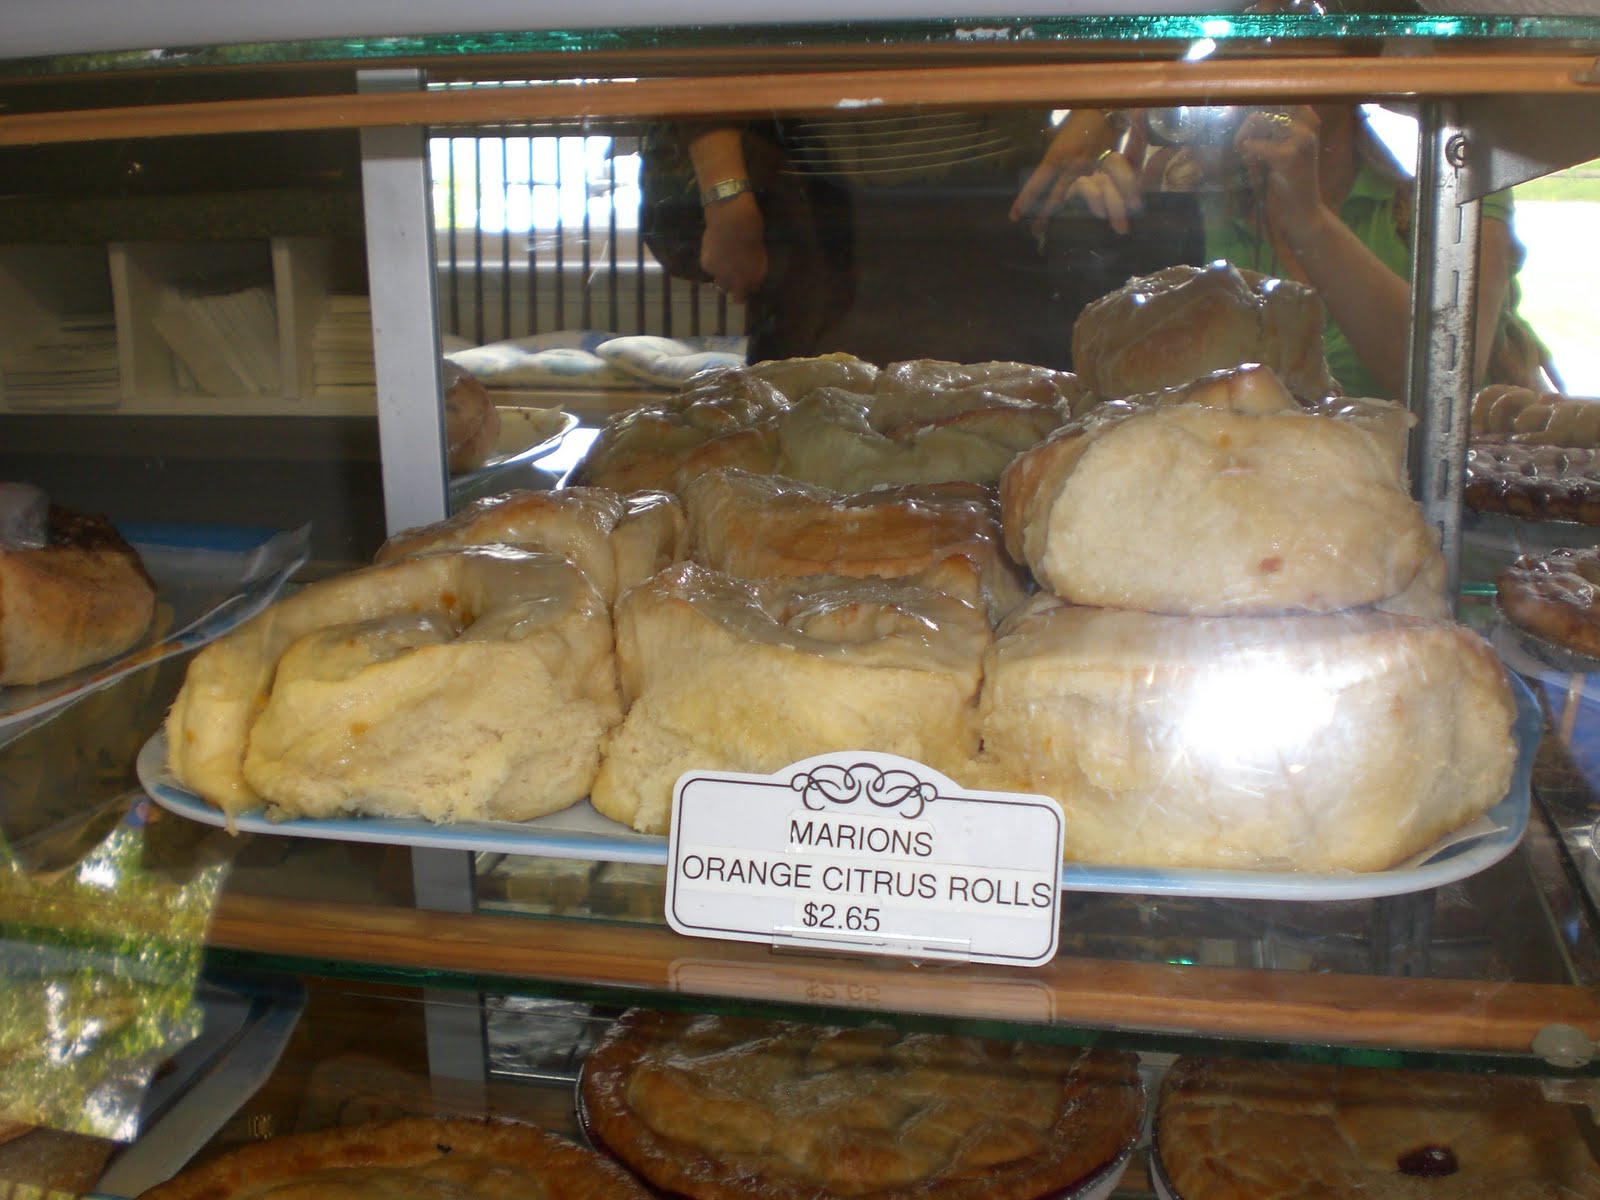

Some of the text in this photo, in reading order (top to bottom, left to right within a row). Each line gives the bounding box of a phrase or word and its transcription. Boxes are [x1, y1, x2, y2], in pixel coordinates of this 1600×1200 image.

[790, 820, 933, 857] MARIONS
[682, 855, 1052, 908] ORANGE CITRUS ROLLS
[802, 902, 880, 932] $2.65
